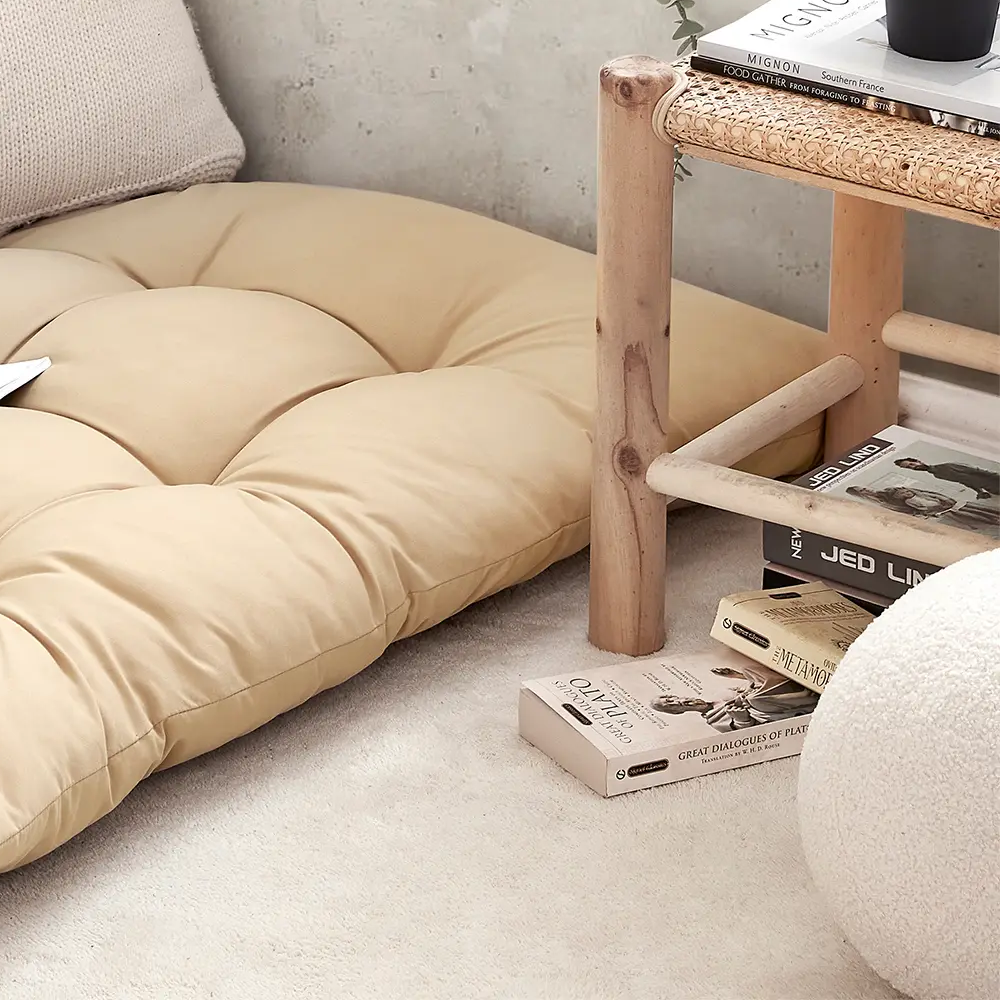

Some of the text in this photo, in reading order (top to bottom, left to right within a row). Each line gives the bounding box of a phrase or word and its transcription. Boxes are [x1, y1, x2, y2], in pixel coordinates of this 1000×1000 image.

[723, 64, 750, 79] FOOD
[751, 71, 787, 88] GATHER
[789, 82, 810, 93] FROM
[811, 87, 848, 102] FORAGING
[849, 96, 860, 104] TO
[747, 53, 885, 93] MIGNON Southern France
[808, 466, 842, 487] JED
[838, 444, 881, 467] LIND
[791, 527, 802, 559] NEW
[820, 546, 876, 574] JED
[551, 680, 604, 720] DIALOGUES
[569, 678, 628, 718] PLATO
[599, 720, 632, 744] GREAT
[615, 719, 634, 729] OF
[678, 746, 710, 761] GREAT
[712, 733, 767, 754] DIALOGUES
[769, 730, 782, 741] OF
